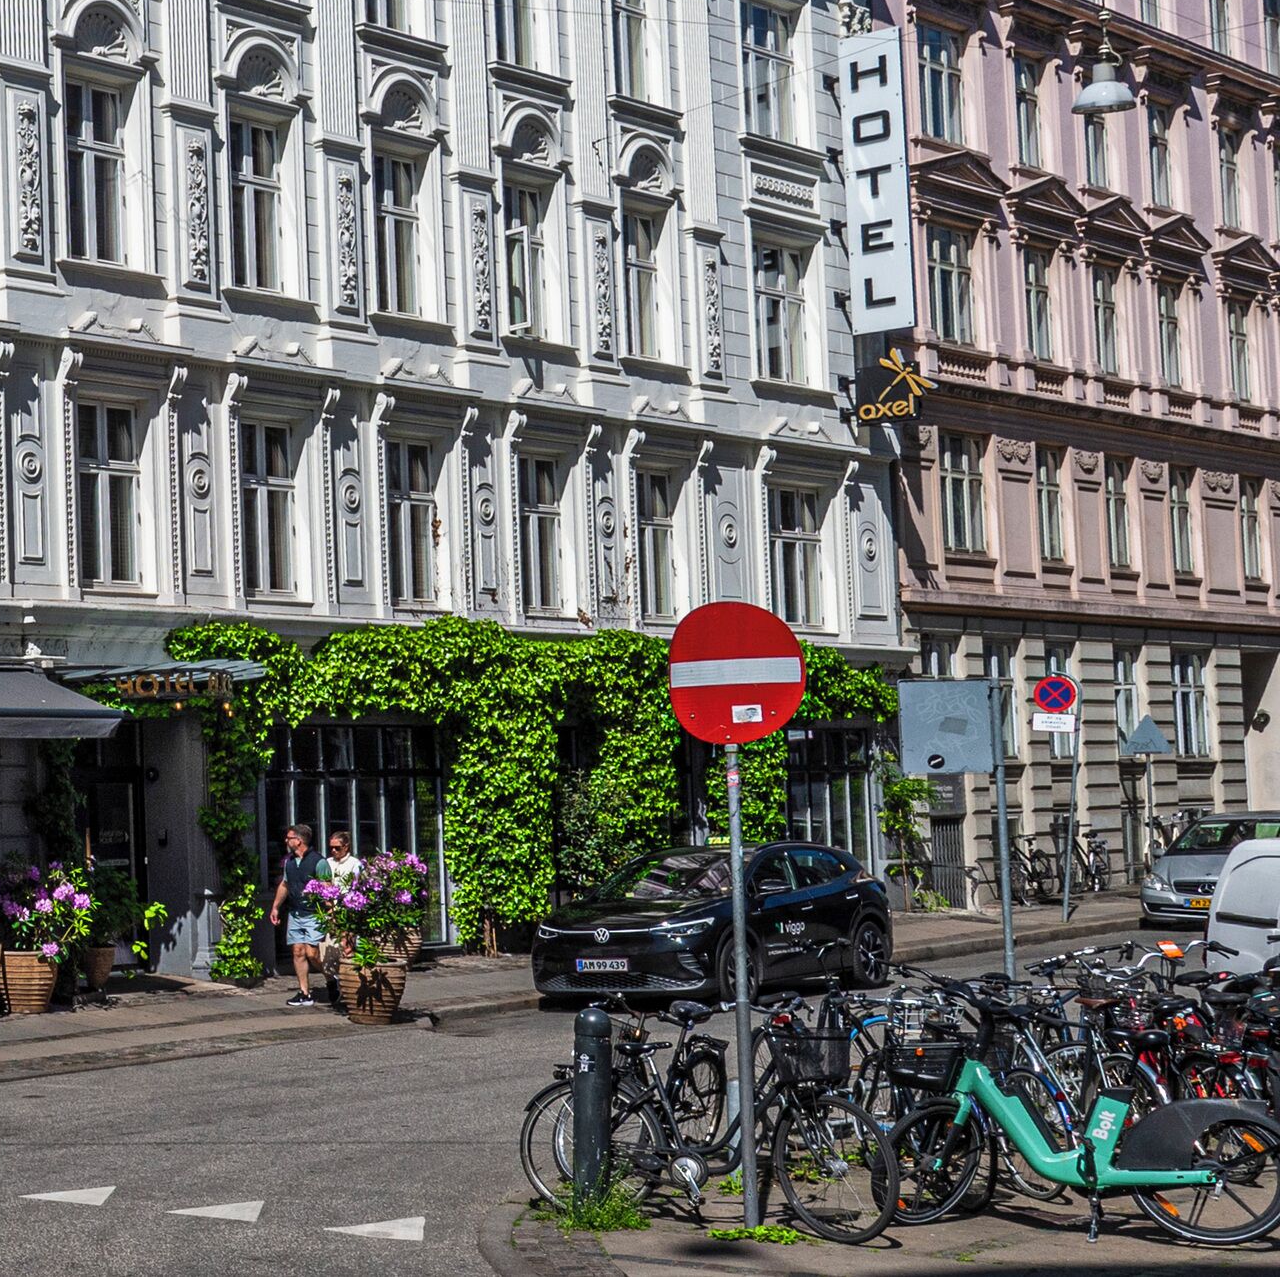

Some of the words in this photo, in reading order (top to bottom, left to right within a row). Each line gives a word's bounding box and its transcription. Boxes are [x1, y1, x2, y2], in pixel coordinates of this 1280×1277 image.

[848, 54, 896, 309] HOTEL
[859, 393, 914, 420] axel
[116, 673, 198, 697] HOTEL
[785, 920, 806, 935] viggo
[583, 961, 595, 970] AM
[595, 961, 608, 970] 99
[609, 961, 626, 970] 439
[1091, 1110, 1116, 1140] Bolt
